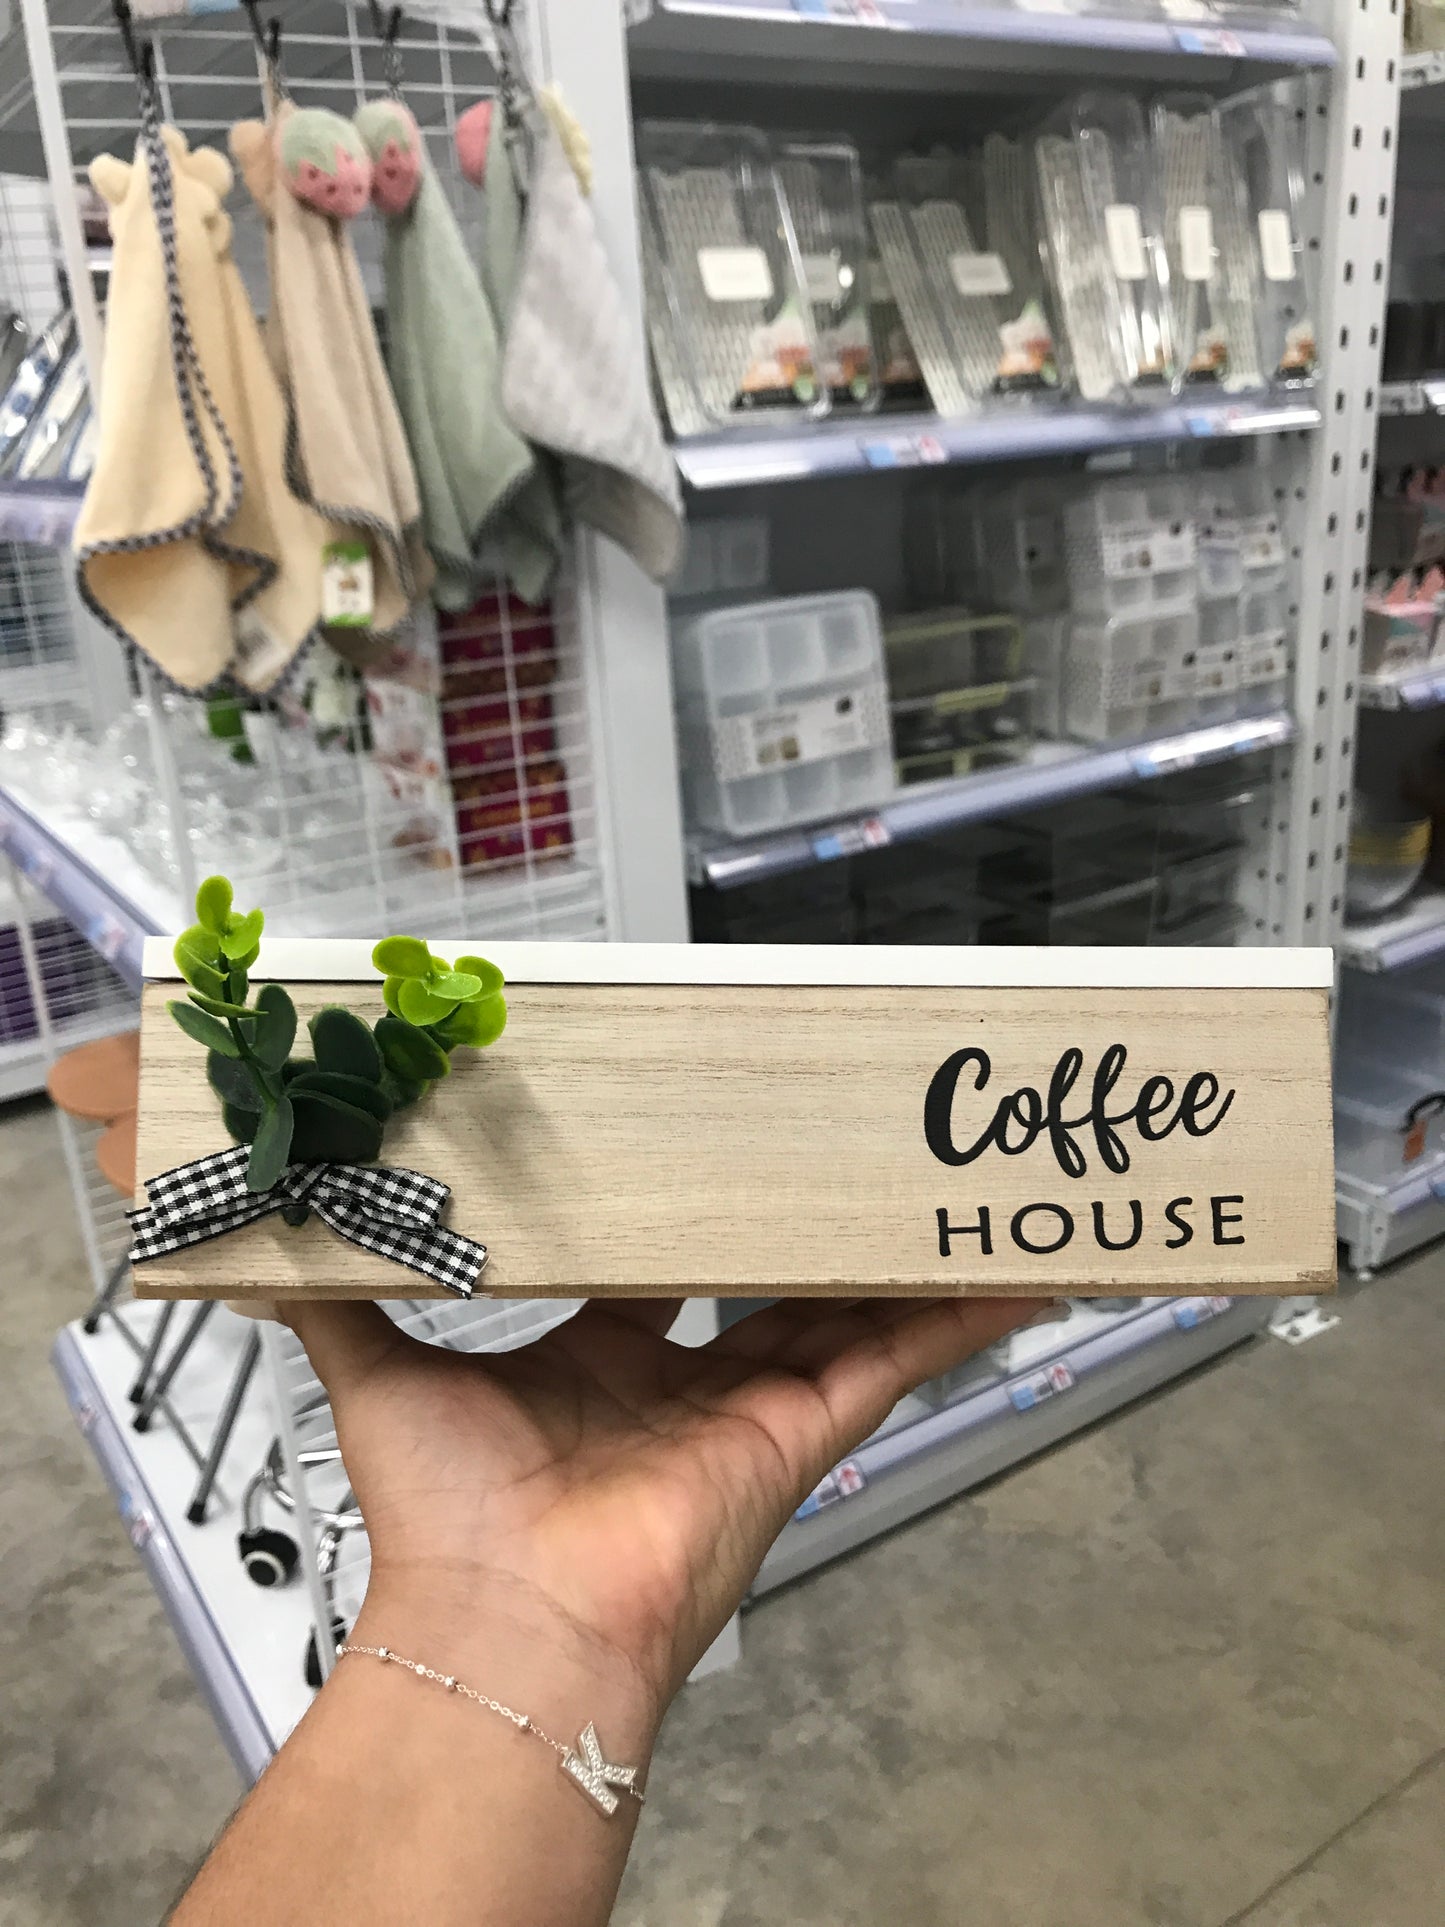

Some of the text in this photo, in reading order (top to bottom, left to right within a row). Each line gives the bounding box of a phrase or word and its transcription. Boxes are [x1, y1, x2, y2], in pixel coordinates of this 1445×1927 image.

[923, 1043, 1236, 1179] Coffee
[935, 1195, 1246, 1258] HOUSE
[561, 1721, 638, 1815] K
